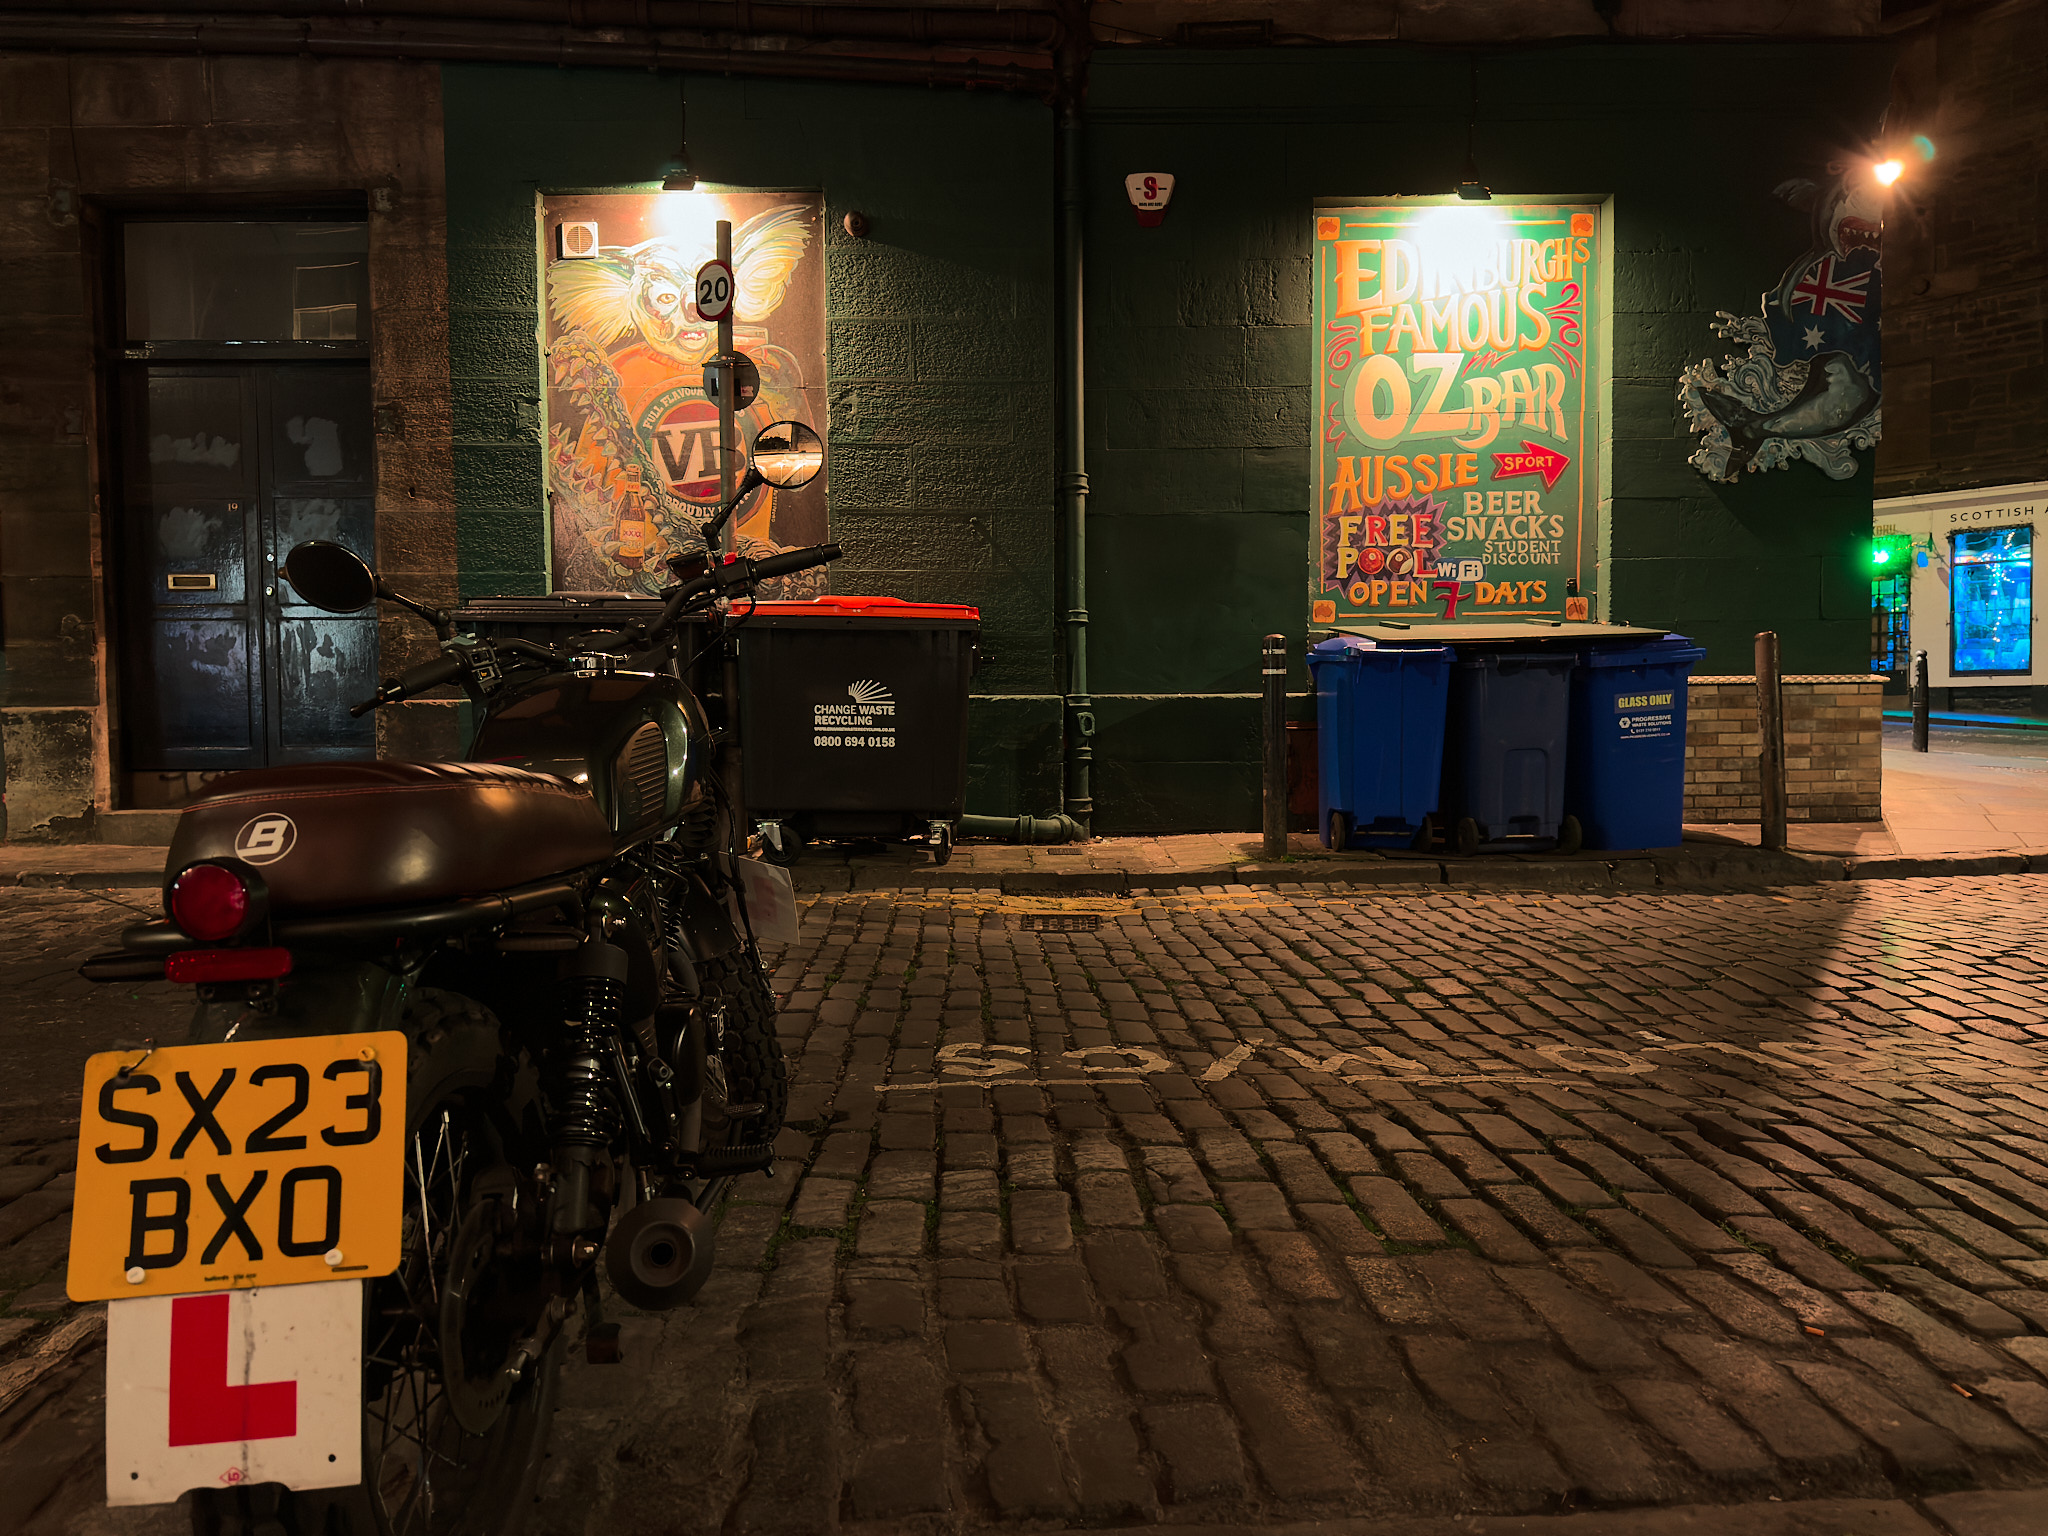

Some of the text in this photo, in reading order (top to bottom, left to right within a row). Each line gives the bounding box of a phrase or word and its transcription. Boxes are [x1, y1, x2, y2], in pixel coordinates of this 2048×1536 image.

[700, 276, 728, 304] 20
[1359, 281, 1552, 358] FAMOUS
[1344, 352, 1569, 451] OZ BAR
[642, 402, 664, 431] FULL
[649, 425, 746, 482] VB
[1504, 455, 1555, 471] SPORT
[1328, 453, 1479, 516] AUSSIE
[664, 493, 715, 517] PROUDLY
[1463, 490, 1544, 516] BEER
[1950, 506, 2034, 522] SCOTTISH
[1338, 513, 1434, 549] FREE
[1447, 514, 1565, 541] SNACKS
[1482, 553, 1562, 566] DISCOUNT
[1484, 540, 1562, 553] STUDENT
[1336, 547, 1438, 579] POOL
[1348, 580, 1548, 620] OPEN 7 DAYS
[814, 704, 896, 715] CHANGE WASTE
[1618, 694, 1672, 708] GLASS ONLY
[814, 715, 873, 726] RECYCLING
[1631, 714, 1672, 722] PROGRESSIVE
[814, 736, 896, 748] 0800 694 0158
[237, 820, 289, 857] B
[94, 1057, 383, 1165] SX23
[124, 1164, 342, 1272] BXO
[169, 1293, 297, 1448] L
